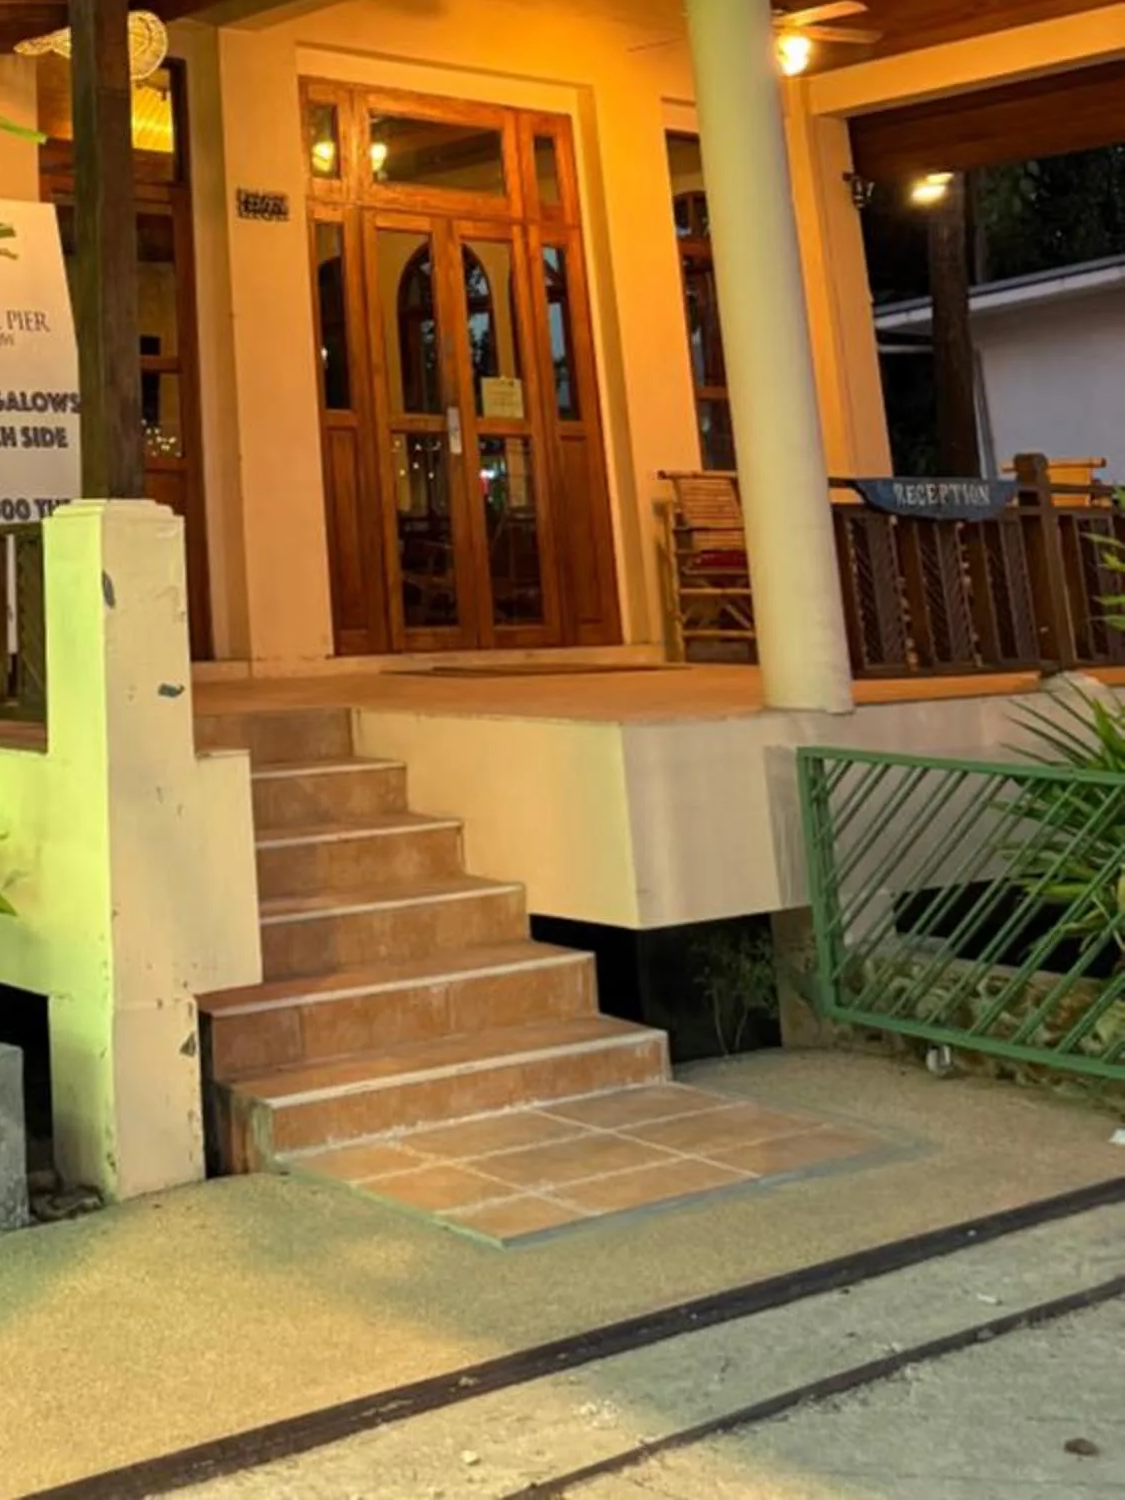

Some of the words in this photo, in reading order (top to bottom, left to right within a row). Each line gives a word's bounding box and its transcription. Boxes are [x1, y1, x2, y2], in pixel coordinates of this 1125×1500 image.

[7, 305, 51, 332] PIER
[22, 426, 68, 448] SIDE
[893, 482, 990, 506] RECEPTION
